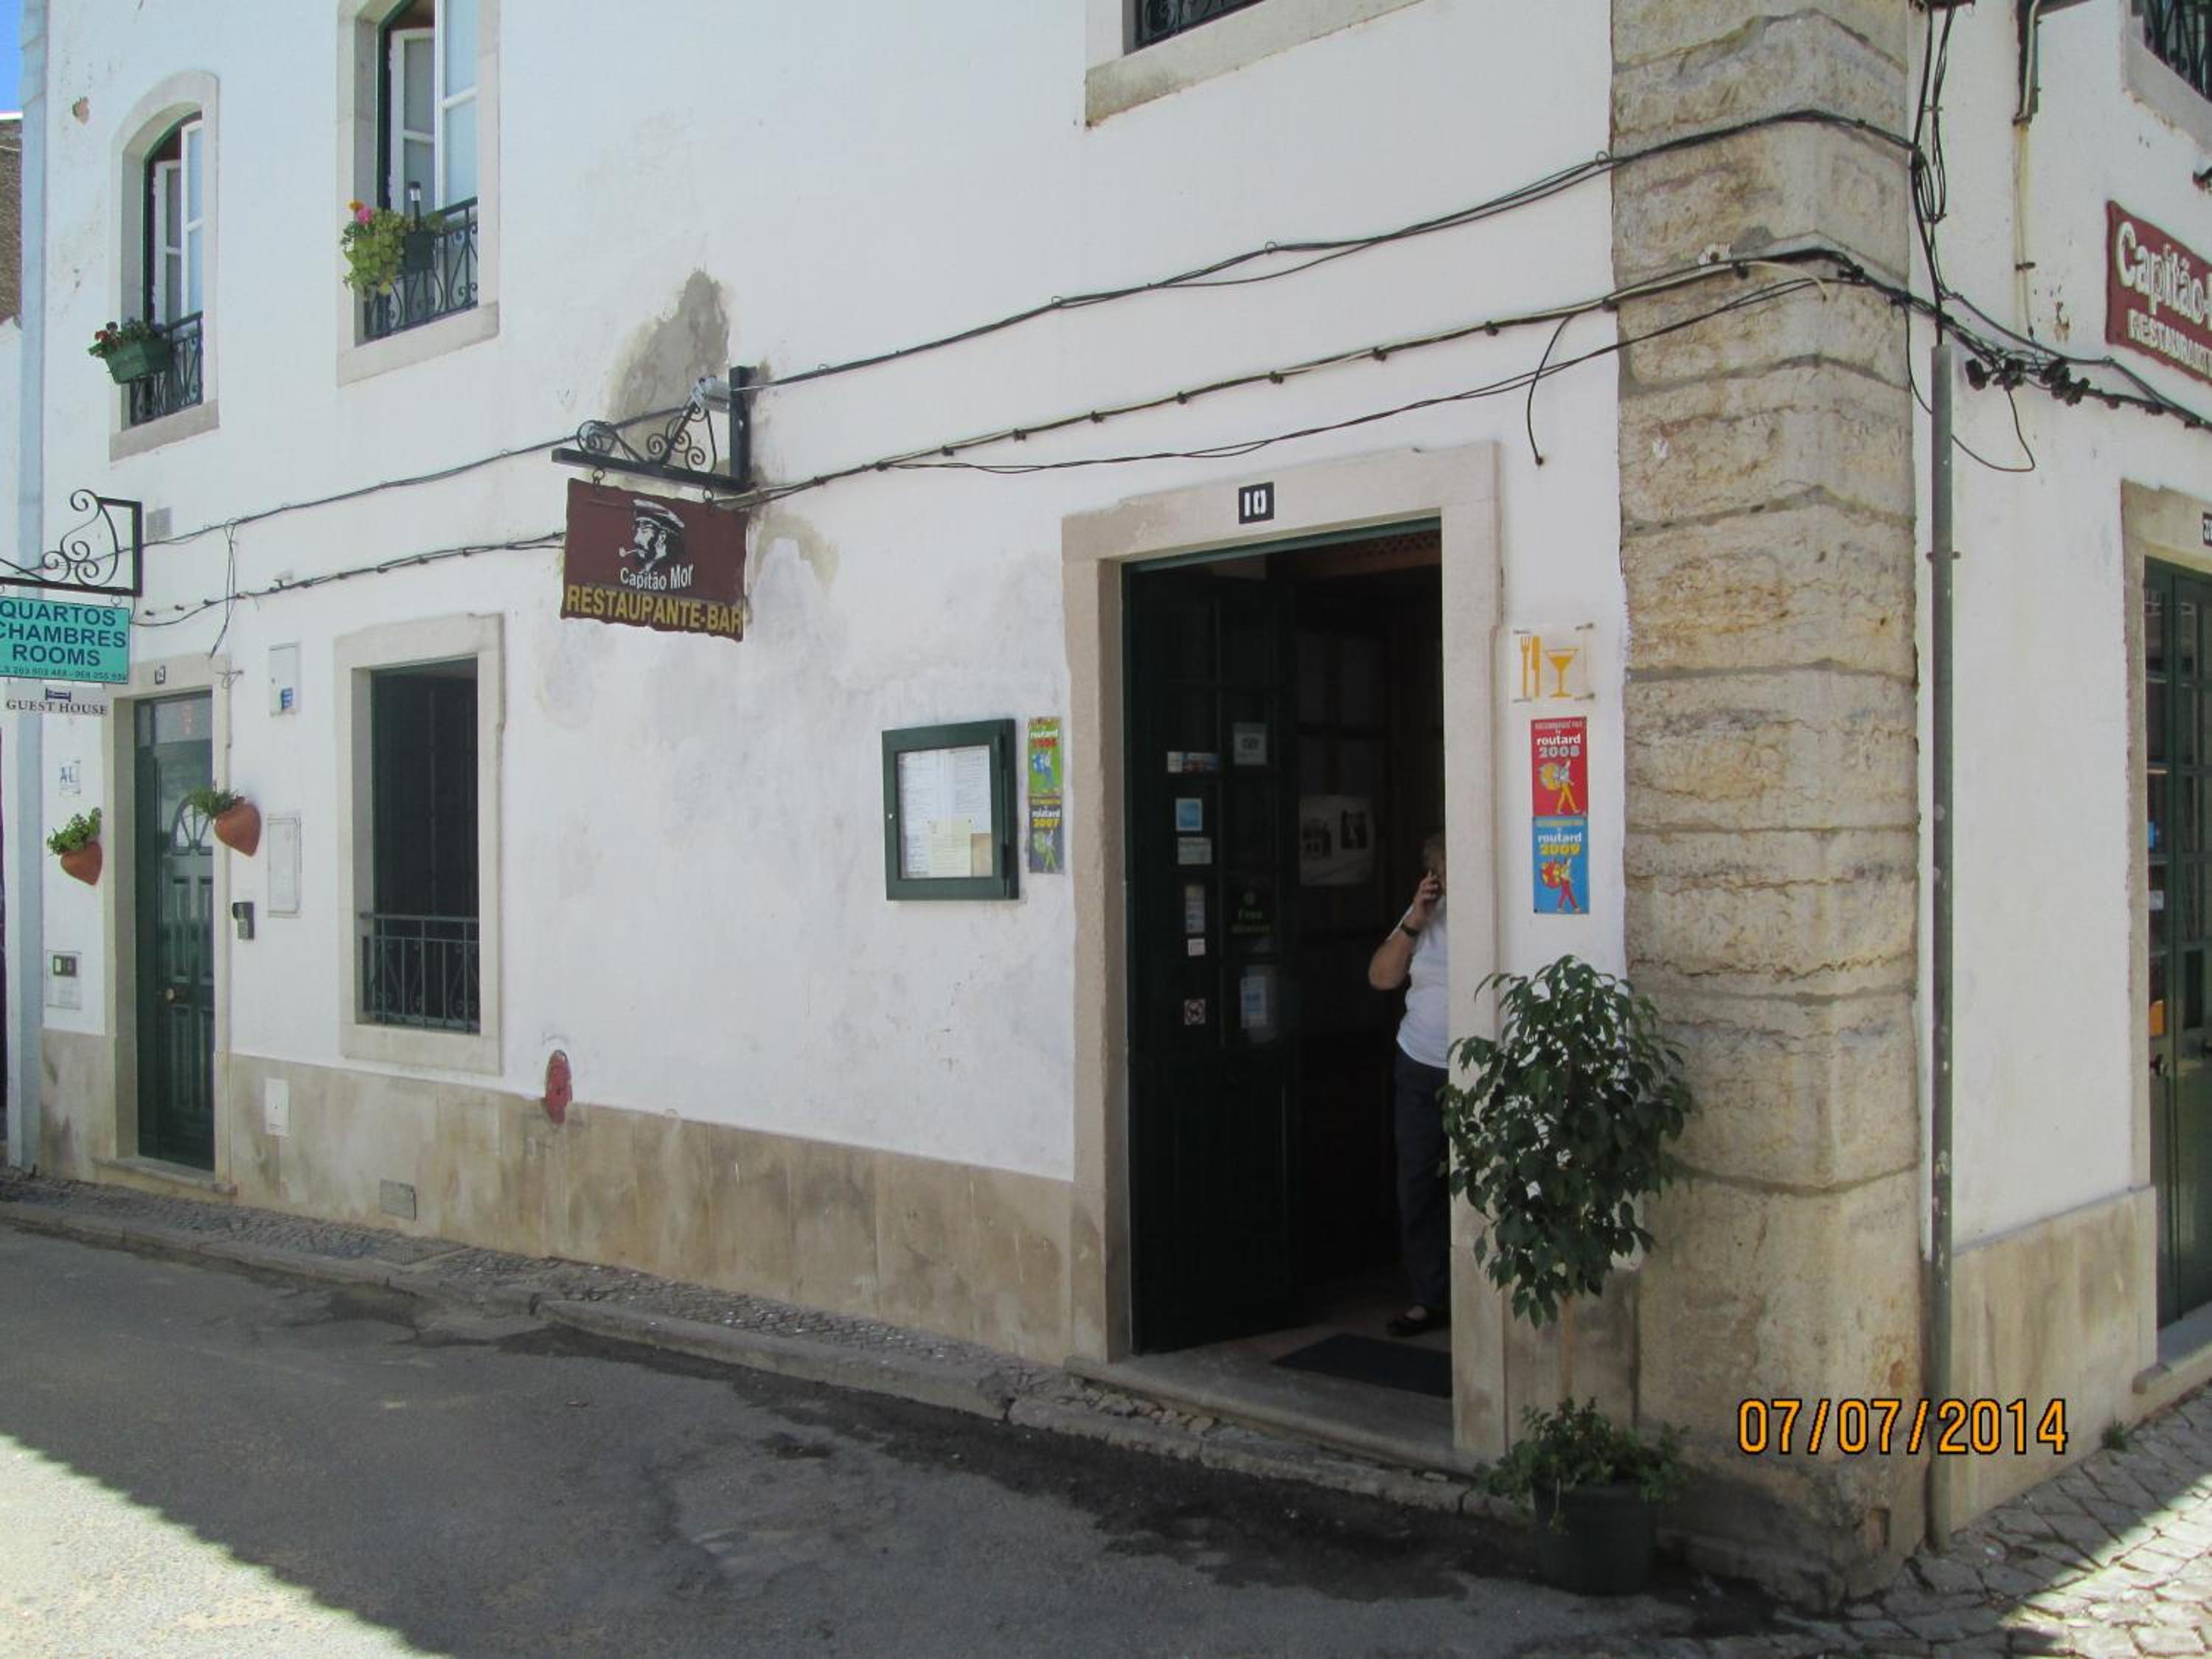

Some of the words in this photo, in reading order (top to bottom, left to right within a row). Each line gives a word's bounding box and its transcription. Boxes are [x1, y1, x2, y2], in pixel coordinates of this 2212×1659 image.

[1244, 490, 1267, 517] 10
[620, 567, 667, 591] Capitão
[670, 564, 694, 589] Mor
[1, 600, 116, 627] QUARTOS
[13, 644, 100, 667] ROOMS
[7, 699, 55, 711] GUEST
[59, 703, 108, 715] HOUSE
[1537, 734, 1581, 745] routard
[1537, 832, 1582, 844] routard
